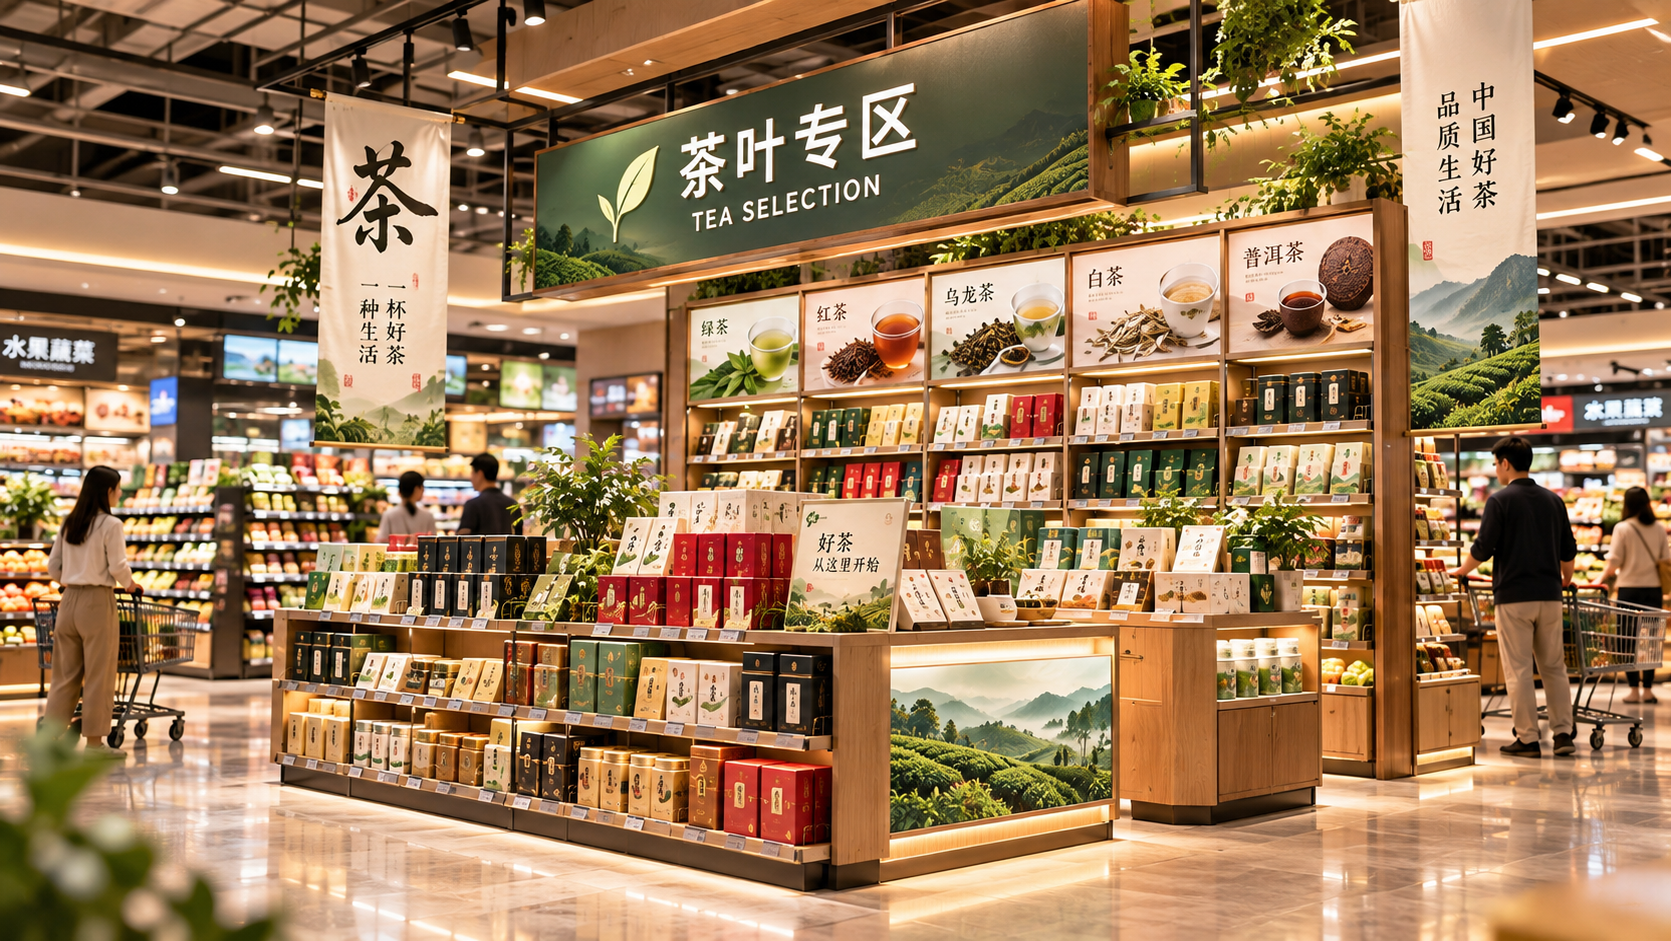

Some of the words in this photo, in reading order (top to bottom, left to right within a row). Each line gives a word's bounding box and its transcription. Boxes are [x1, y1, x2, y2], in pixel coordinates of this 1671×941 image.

[680, 83, 917, 199] 茶叶专区
[1437, 90, 1463, 216] 品质生活
[1471, 81, 1498, 210] 中国好茶
[336, 140, 438, 253] 茶
[692, 206, 733, 232] TEA
[742, 174, 881, 222] SELECTION
[1088, 265, 1124, 289] 白茶
[1243, 240, 1304, 270] 普洱茶
[816, 302, 847, 323] 红茶
[944, 282, 995, 307] 乌龙茶
[359, 283, 380, 365] 一种生活
[386, 285, 407, 365] 一杯好茶
[701, 318, 728, 338] 绿茶
[812, 557, 880, 573] 从这里开始
[817, 532, 853, 554] 好茶
